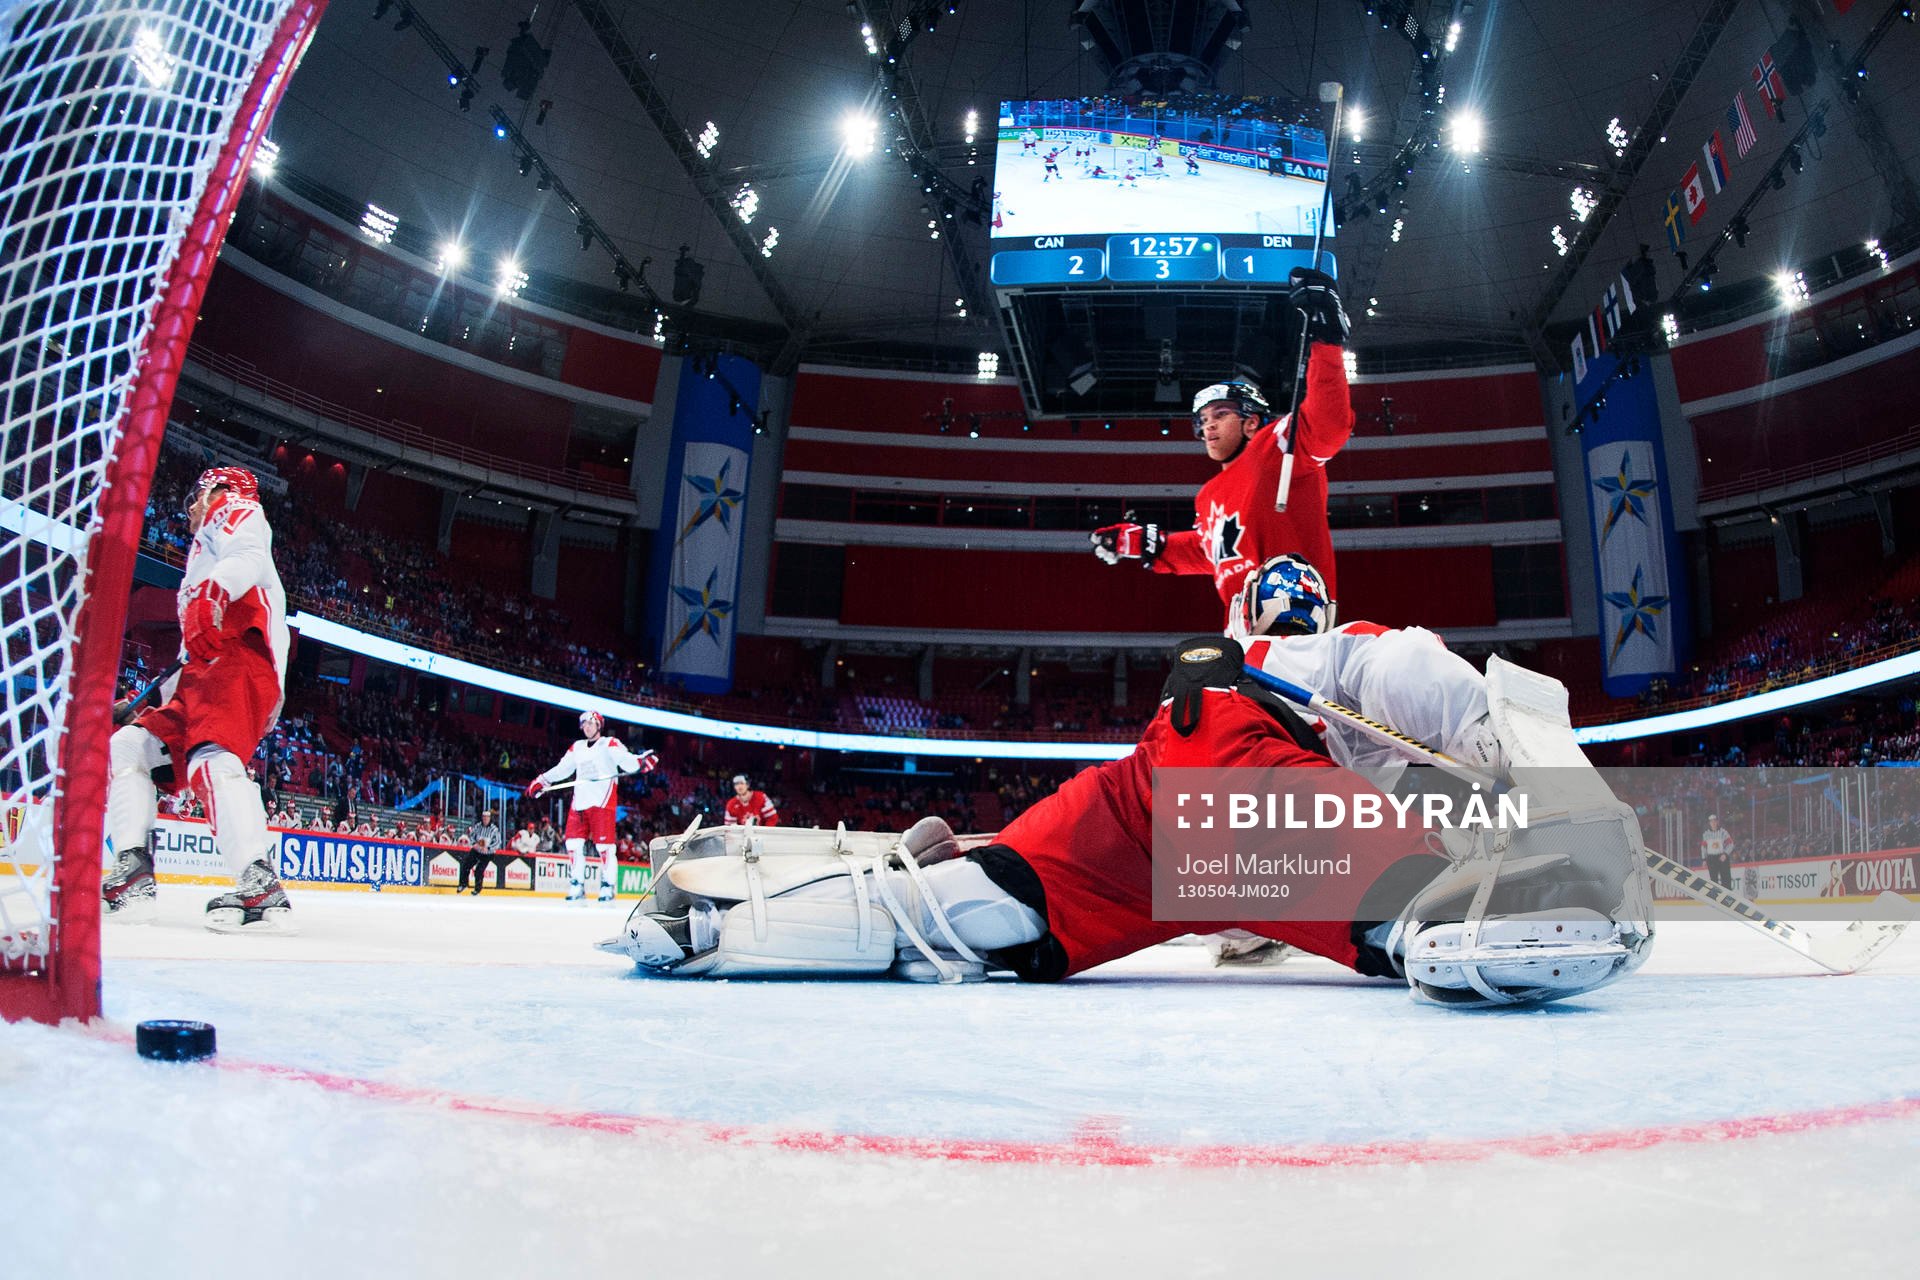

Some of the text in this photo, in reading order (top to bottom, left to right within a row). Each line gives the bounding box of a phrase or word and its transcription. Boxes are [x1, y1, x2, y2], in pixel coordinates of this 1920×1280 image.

[1216, 150, 1255, 164] zepter
[1034, 236, 1065, 249] CAN
[1129, 237, 1199, 256] 12:57
[1263, 235, 1293, 248] DEN
[1068, 256, 1085, 275] 2
[1155, 260, 1170, 279] 3
[1242, 255, 1254, 274] 1
[283, 837, 420, 883] SAMSUNG
[1777, 873, 1817, 889] TISSOT
